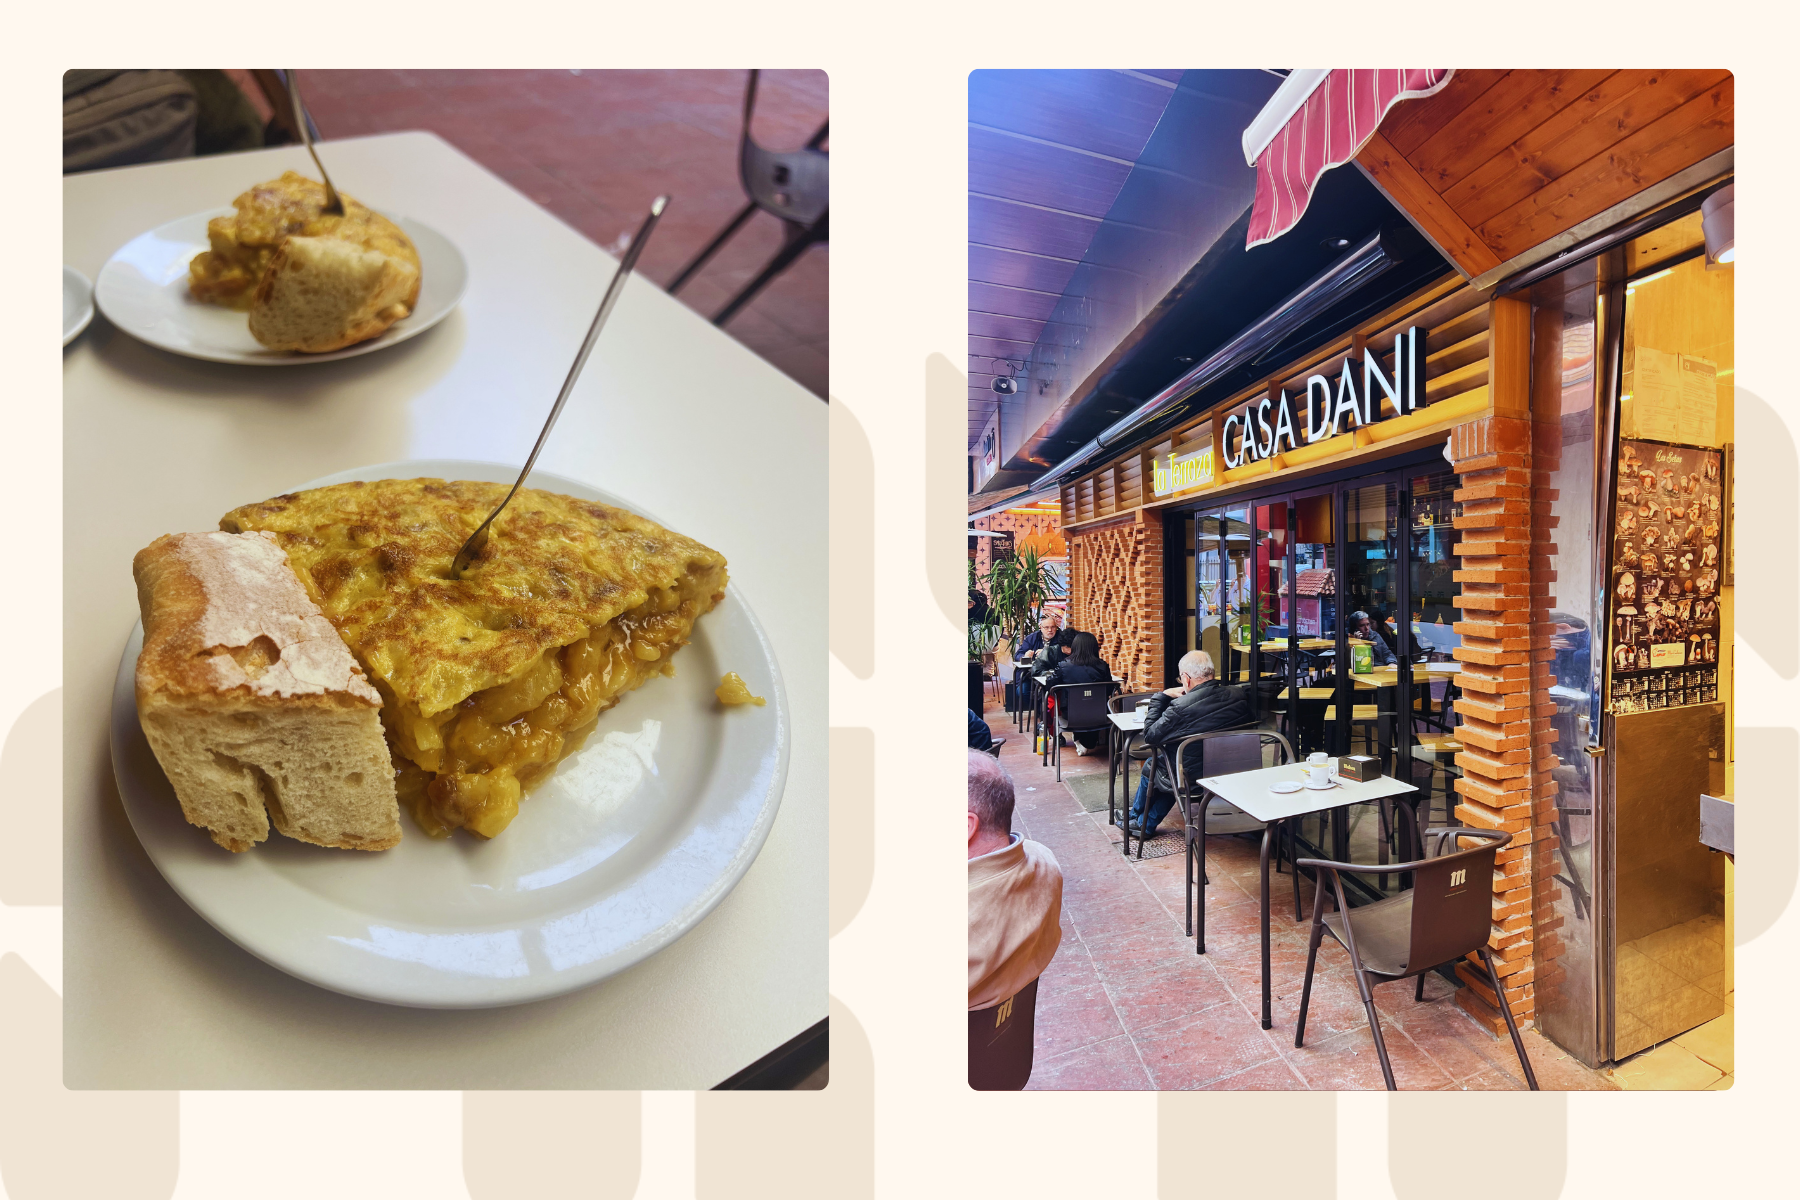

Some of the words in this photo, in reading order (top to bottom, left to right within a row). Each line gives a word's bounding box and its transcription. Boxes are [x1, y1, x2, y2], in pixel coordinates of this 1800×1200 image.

[1223, 388, 1301, 468] CASA
[1308, 326, 1422, 443] DANI
[1167, 452, 1214, 488] Terraza
